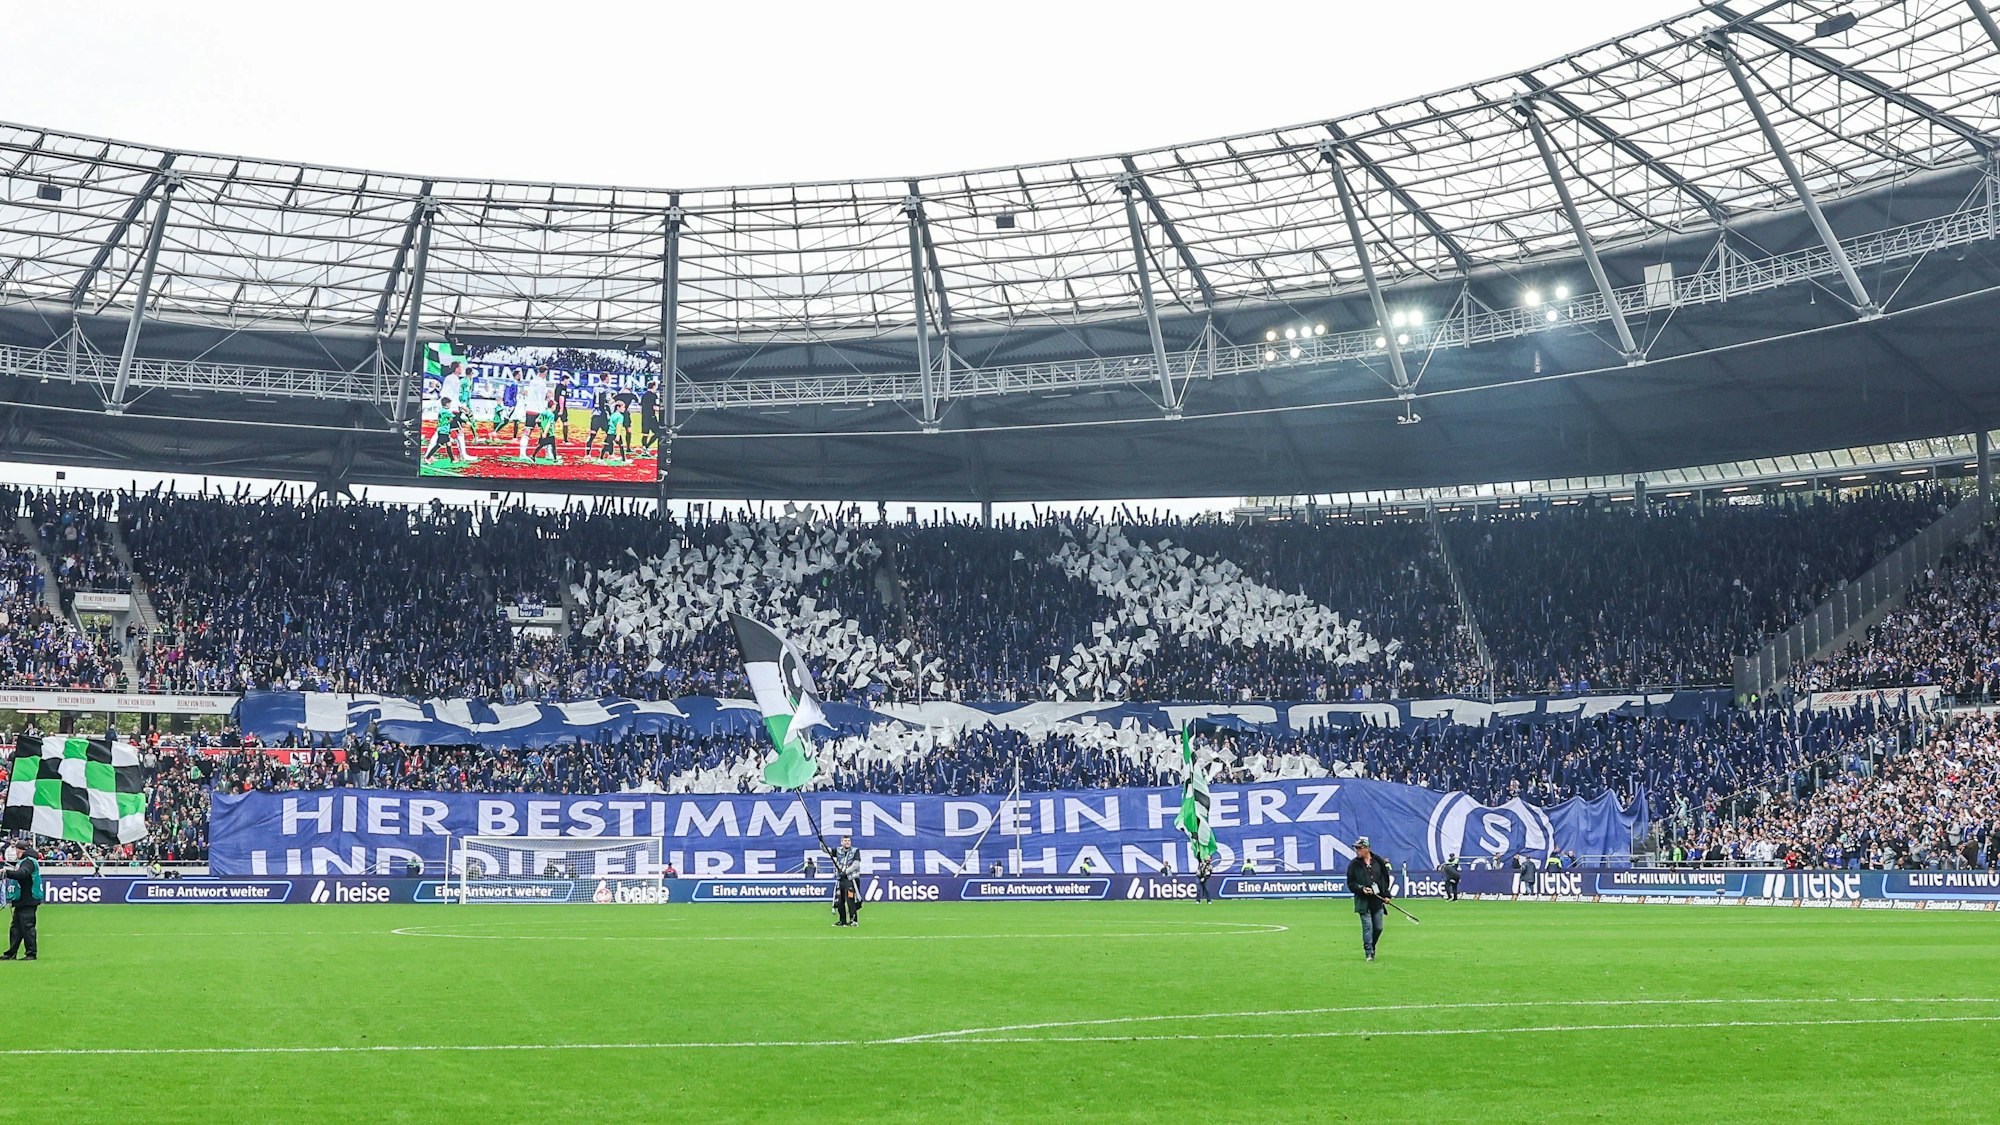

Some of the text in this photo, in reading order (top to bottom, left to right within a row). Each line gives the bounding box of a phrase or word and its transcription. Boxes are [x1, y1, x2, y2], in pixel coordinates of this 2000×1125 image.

[282, 784, 1340, 837] HIER BESTIMMEN DEIN HERZ
[251, 847, 424, 875] UND
[45, 881, 101, 902] heise
[147, 885, 270, 897] Eine Antwort weiter
[335, 881, 390, 902] heise
[435, 886, 553, 897] Eine Antwort weiter
[712, 884, 827, 896] Eine Antwort weiter
[888, 880, 940, 901] heise
[980, 882, 1091, 895] Eine Antwort weiter
[1149, 878, 1197, 898] heise
[1237, 880, 1344, 893] Eine Antwort weiter
[1405, 876, 1446, 896] heise
